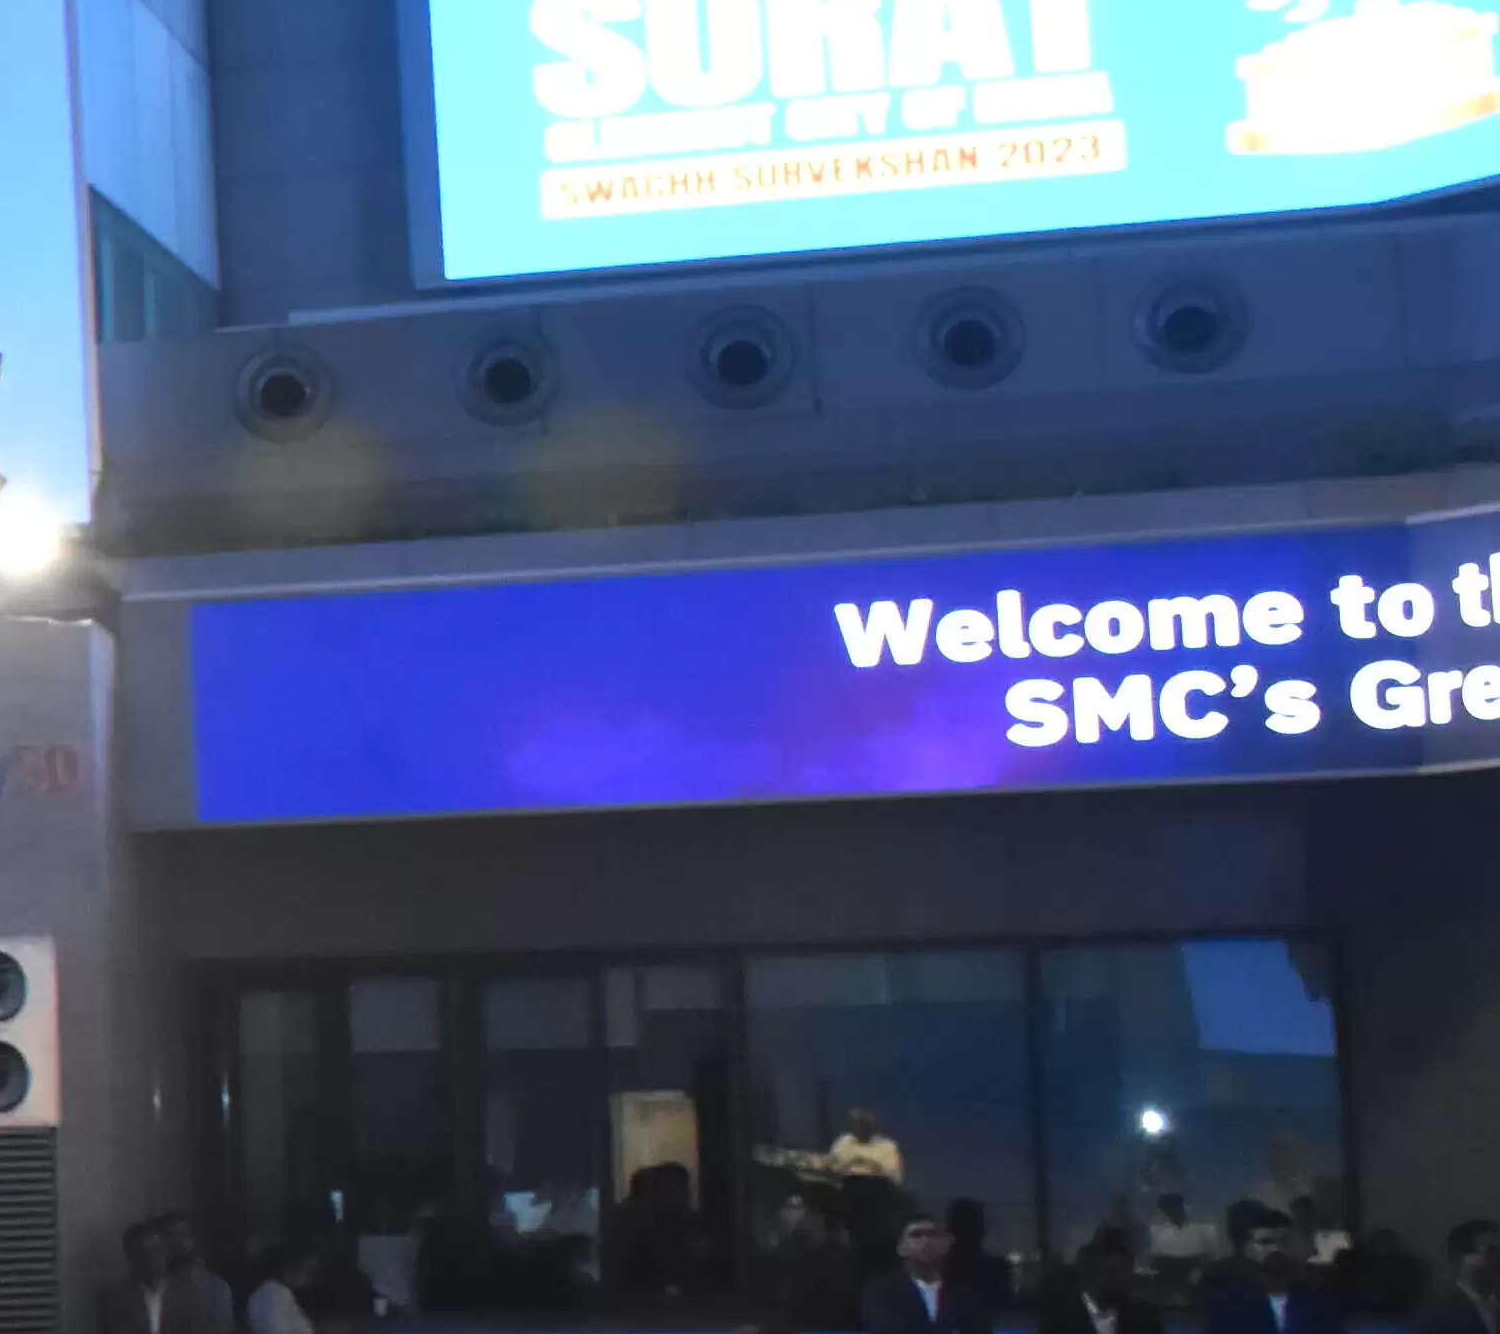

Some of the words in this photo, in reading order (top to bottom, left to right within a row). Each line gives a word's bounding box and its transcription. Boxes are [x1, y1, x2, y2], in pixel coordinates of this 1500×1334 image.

[559, 171, 719, 207] SWACHH
[733, 144, 980, 193] SURVEKSHAN
[999, 133, 1102, 169] 2023
[834, 588, 1304, 668] Welcome
[1330, 574, 1434, 639] to
[1452, 551, 1500, 629] t
